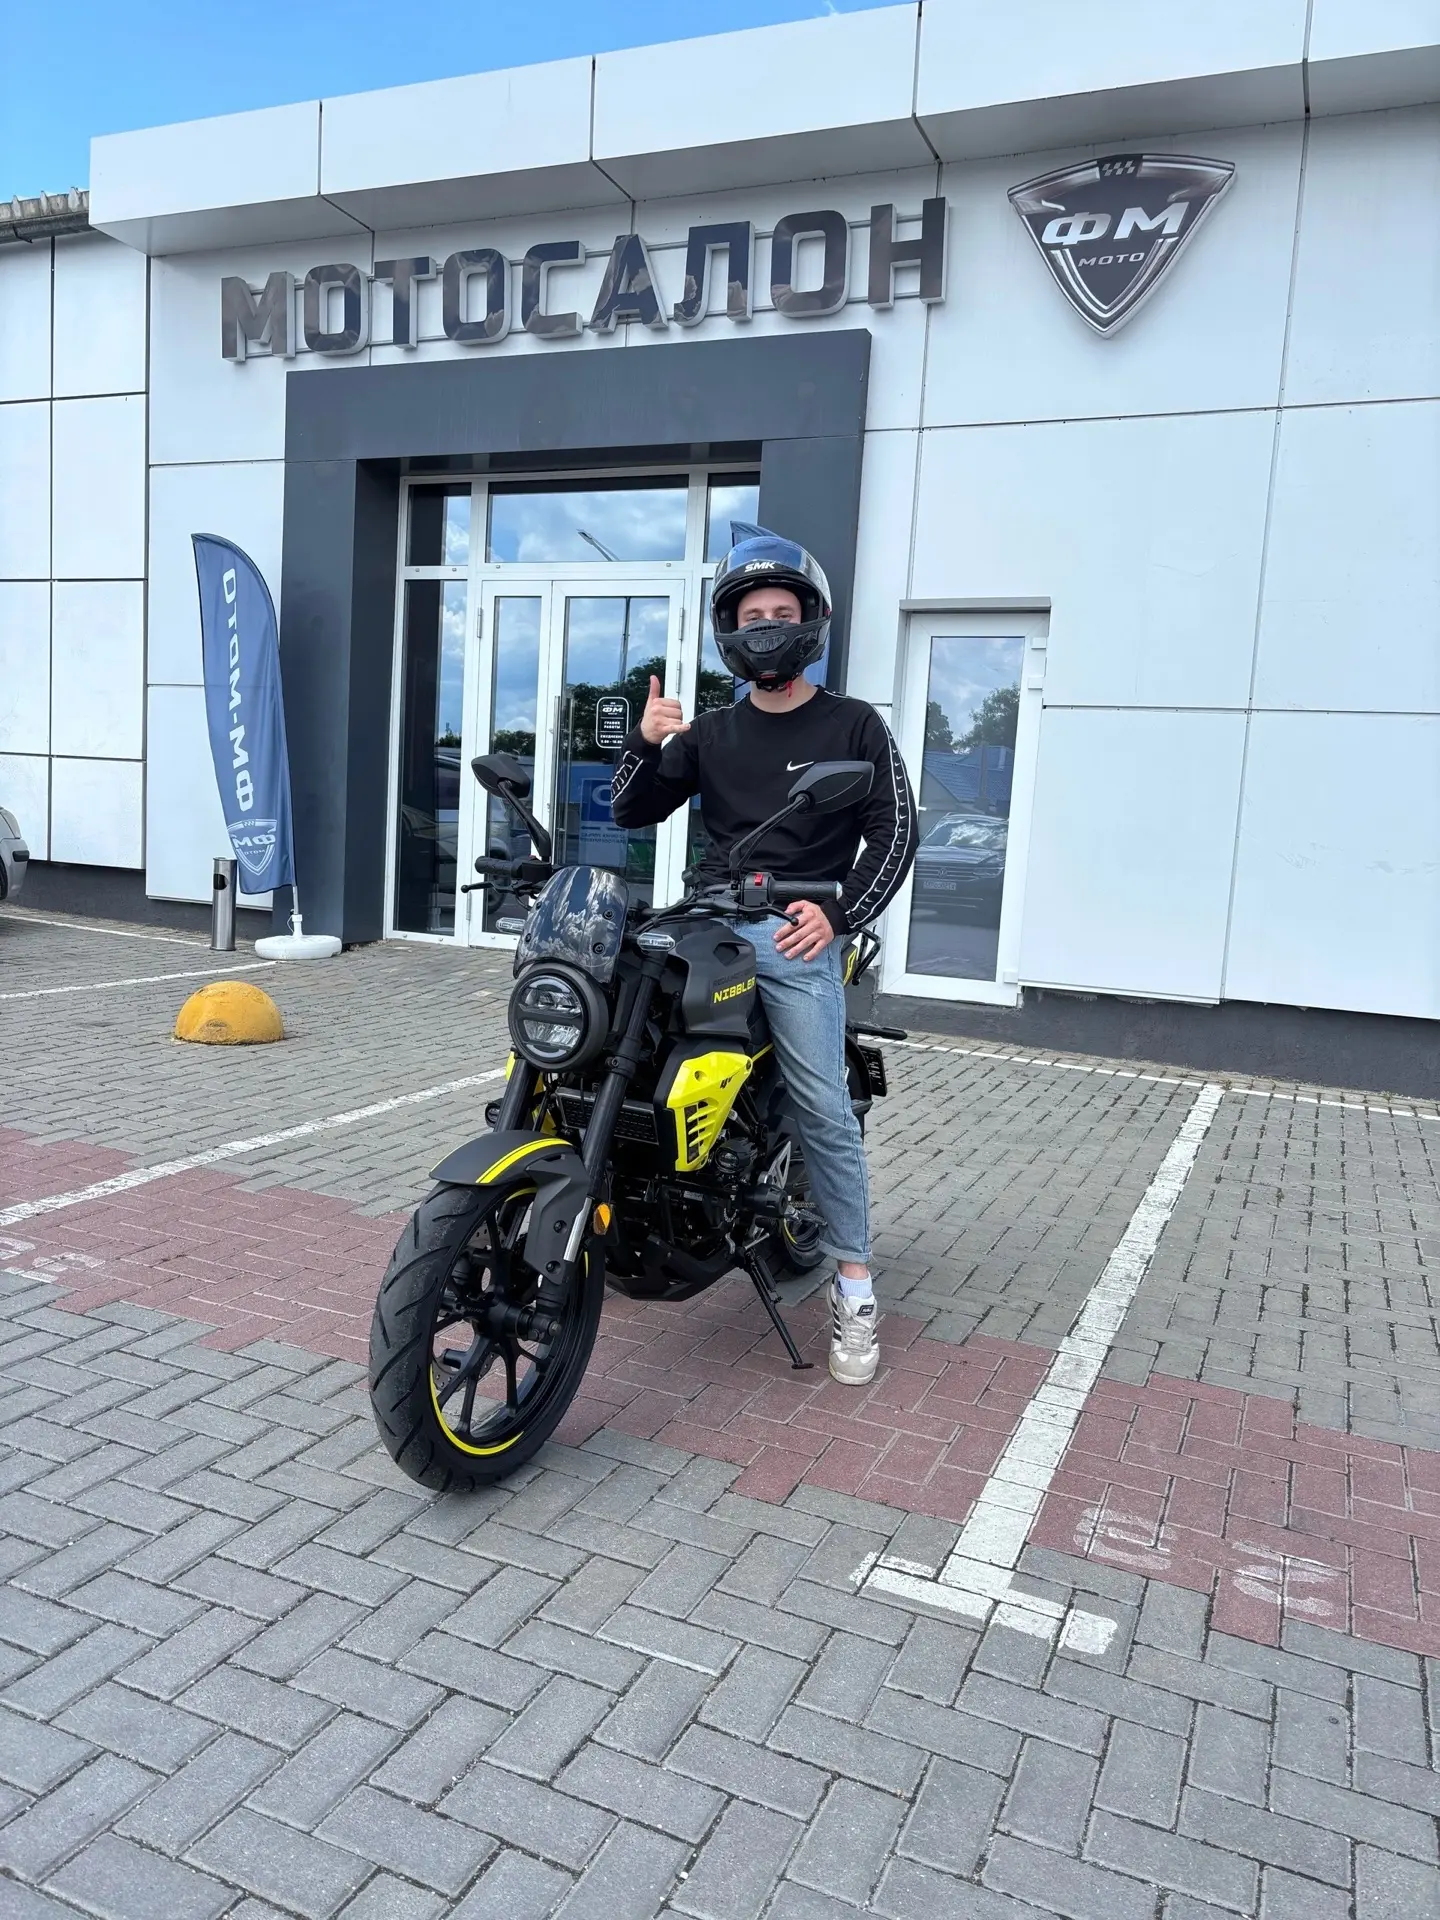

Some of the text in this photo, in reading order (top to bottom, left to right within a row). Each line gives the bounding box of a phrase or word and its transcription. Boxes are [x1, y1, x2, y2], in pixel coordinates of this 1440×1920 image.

[1041, 201, 1190, 246] ФМ
[1077, 252, 1145, 267] МОТО
[221, 196, 948, 362] МОТОСАЛОН
[744, 560, 776, 573] SMK
